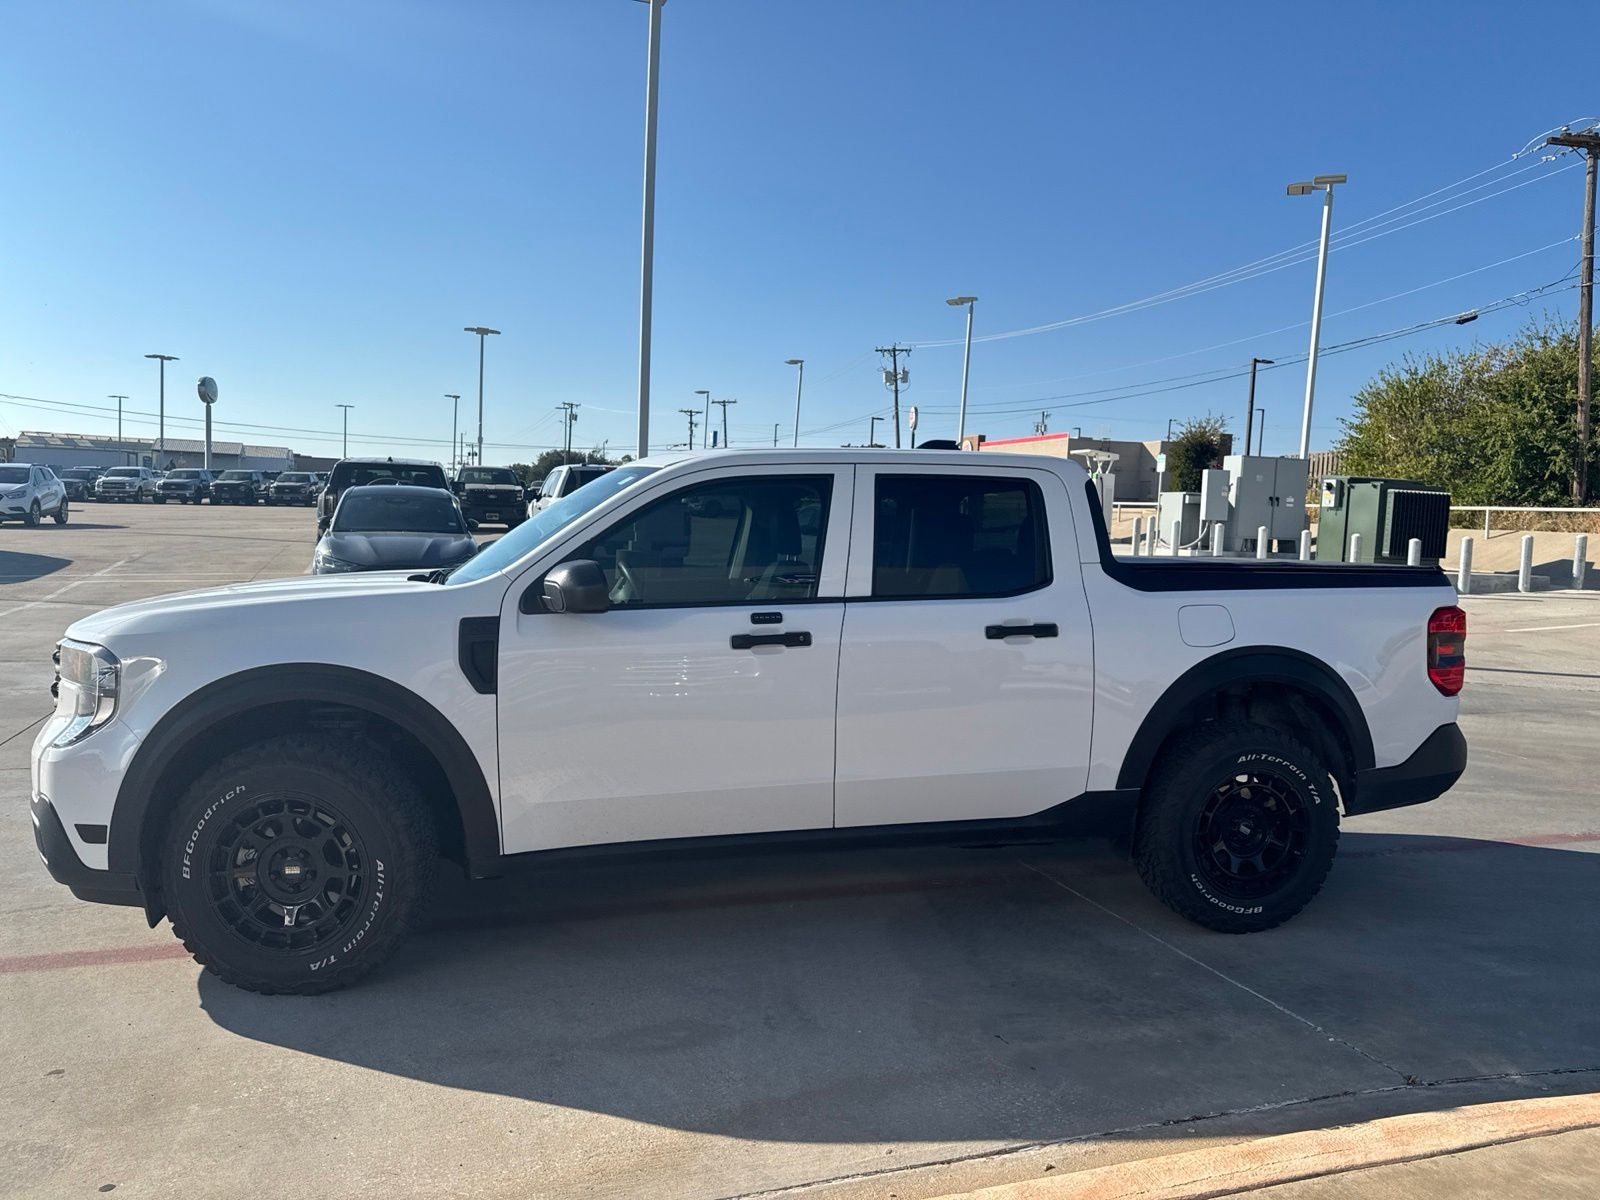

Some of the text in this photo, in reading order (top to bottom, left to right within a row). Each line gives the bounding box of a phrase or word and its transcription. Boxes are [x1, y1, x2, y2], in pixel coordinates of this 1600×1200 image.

[1237, 753, 1321, 805] All-Terrain T/A
[182, 784, 247, 879] BFGoodrich
[310, 859, 386, 971] All-Terrain T/A
[1190, 873, 1263, 915] BFGoodrich
